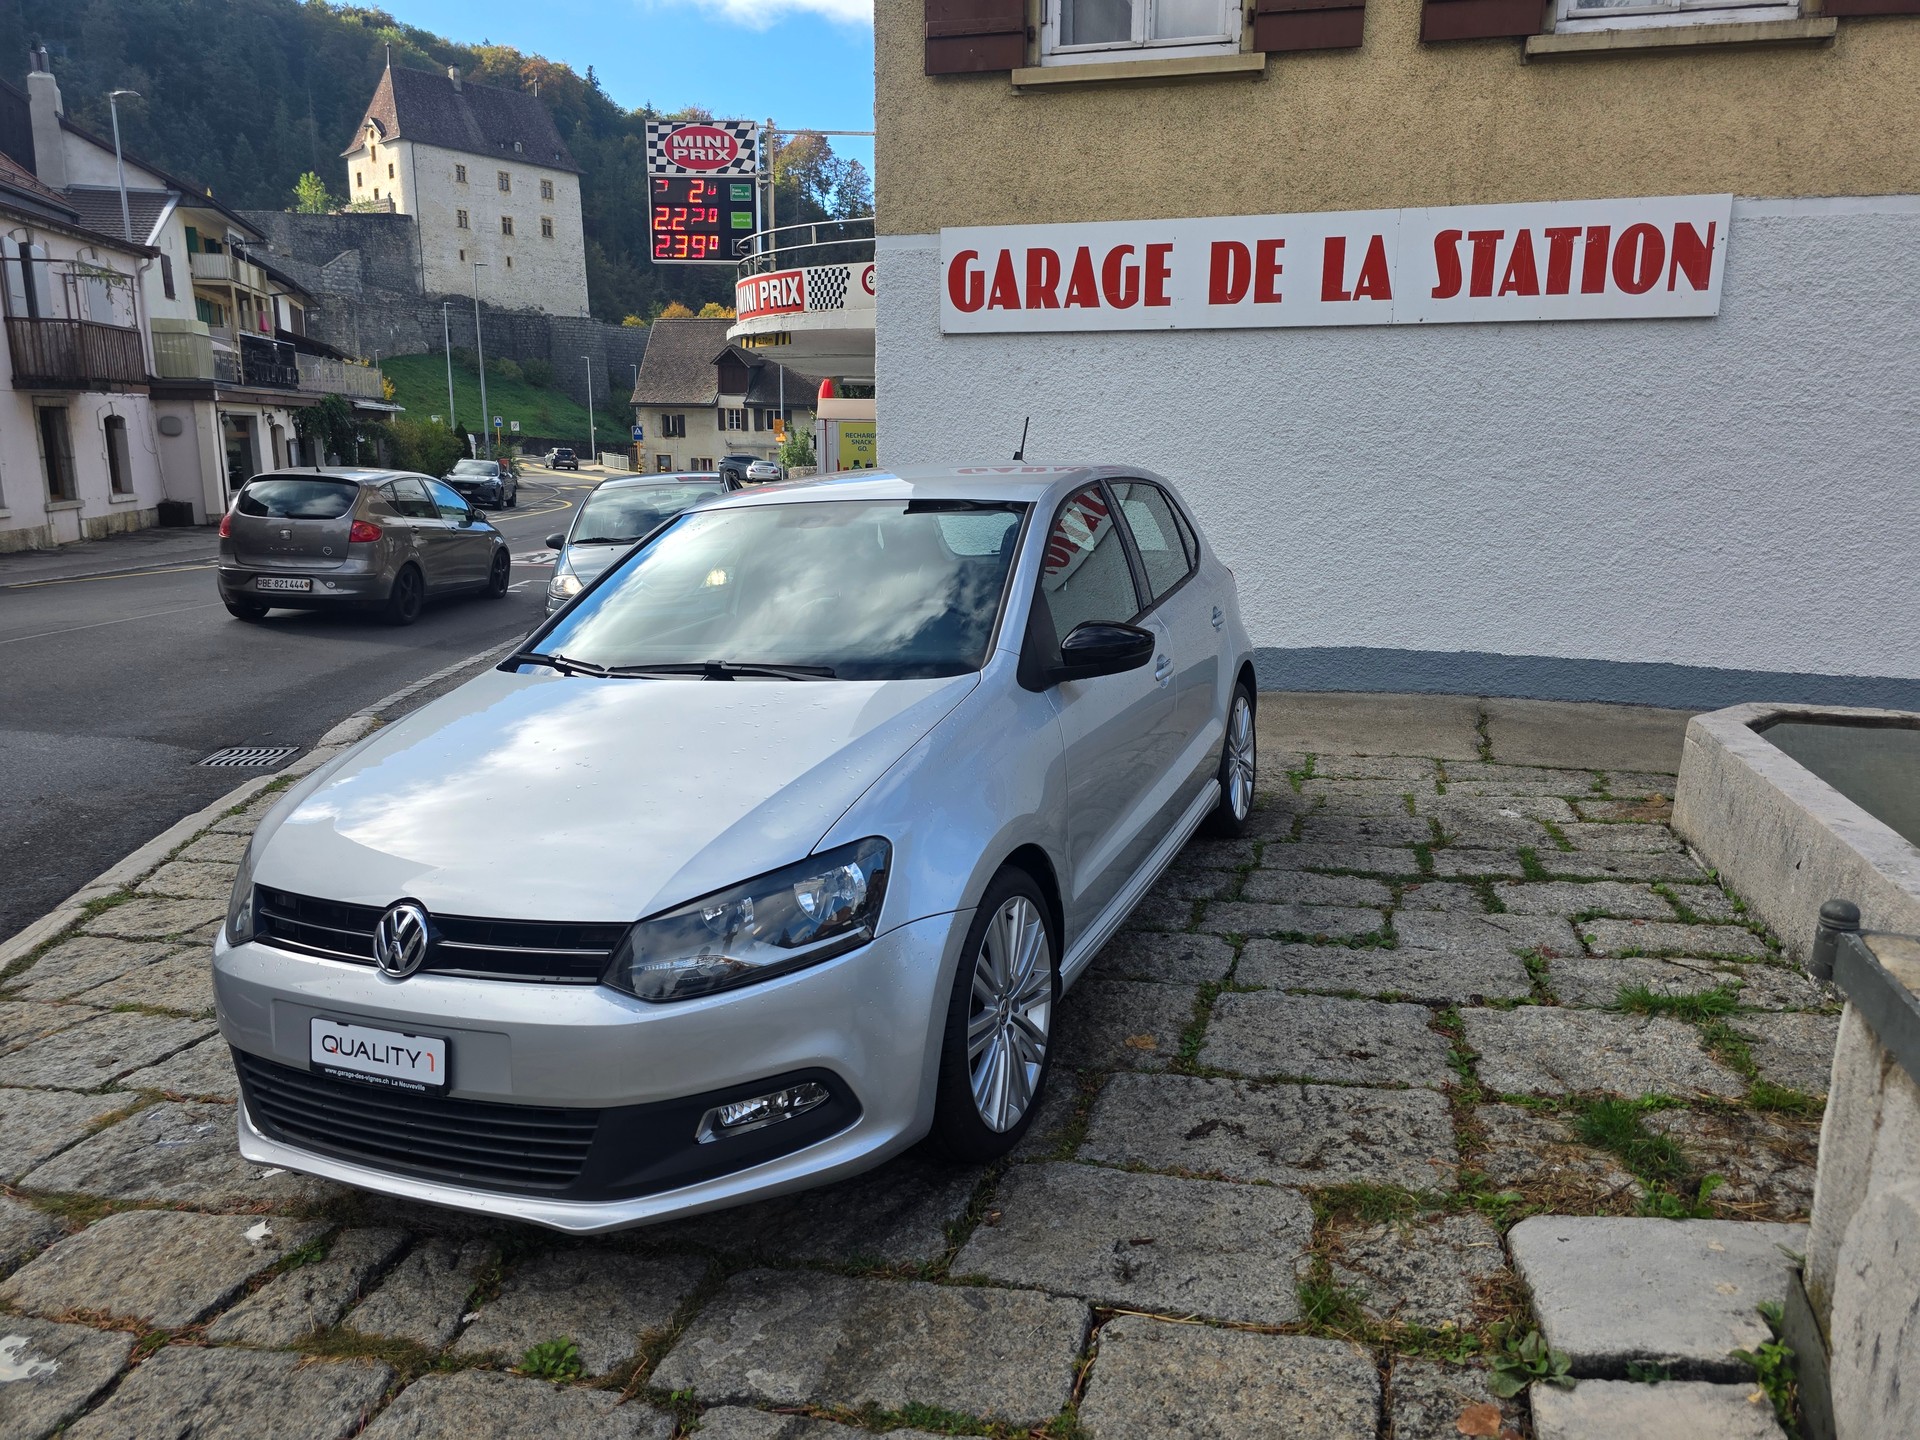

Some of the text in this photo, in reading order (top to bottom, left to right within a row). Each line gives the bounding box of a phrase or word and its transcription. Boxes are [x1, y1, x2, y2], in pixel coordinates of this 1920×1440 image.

[672, 135, 730, 148] MINI
[672, 148, 731, 160] PRIX
[947, 221, 1717, 313] GARAGE DE LA STATION
[738, 276, 802, 313] MINI PRIX
[324, 1067, 390, 1085] www.garage-des-vignes.ch
[399, 1081, 426, 1092] Neuveville
